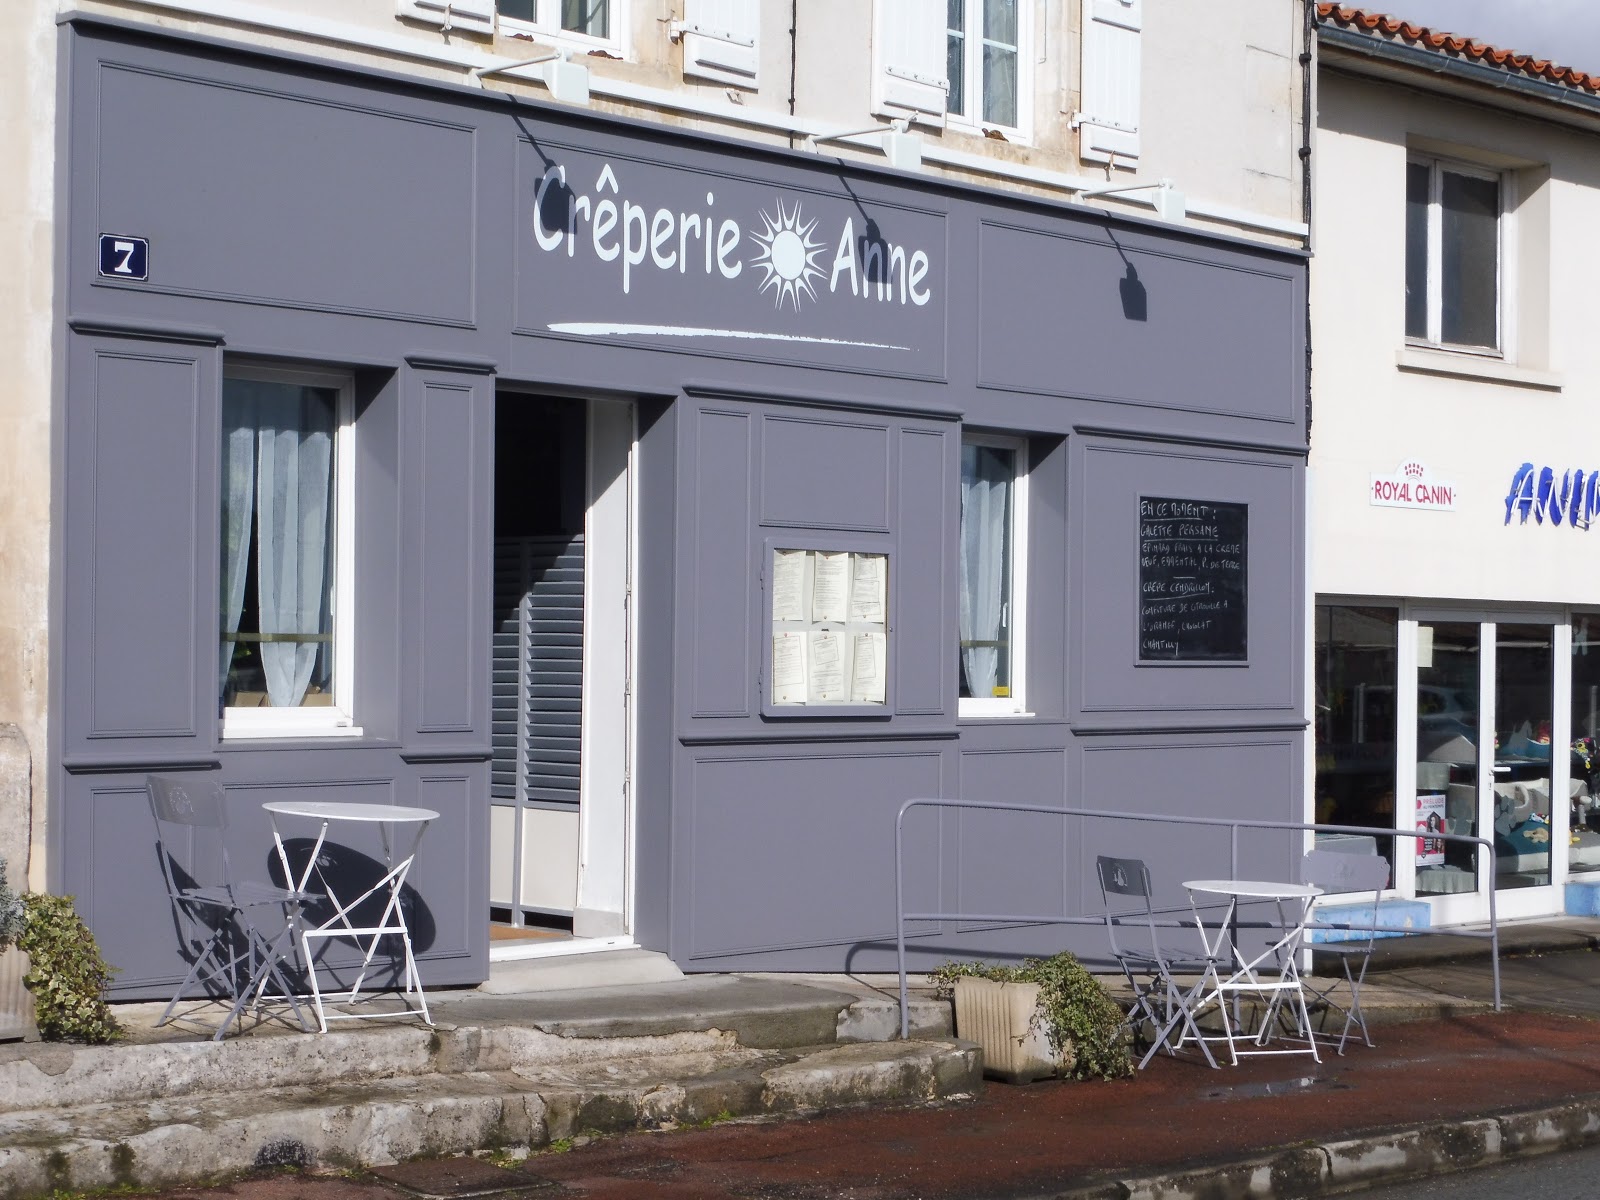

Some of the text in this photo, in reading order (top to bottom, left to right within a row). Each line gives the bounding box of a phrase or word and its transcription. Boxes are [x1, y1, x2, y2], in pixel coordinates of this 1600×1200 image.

[534, 163, 931, 306] Crêperie Anne
[114, 241, 135, 274] 7
[1375, 480, 1452, 506] ROYAL CANIN
[1140, 501, 1154, 516] EN
[1156, 503, 1168, 516] CE
[1141, 524, 1173, 537] GALETTE
[1205, 544, 1213, 553] LA
